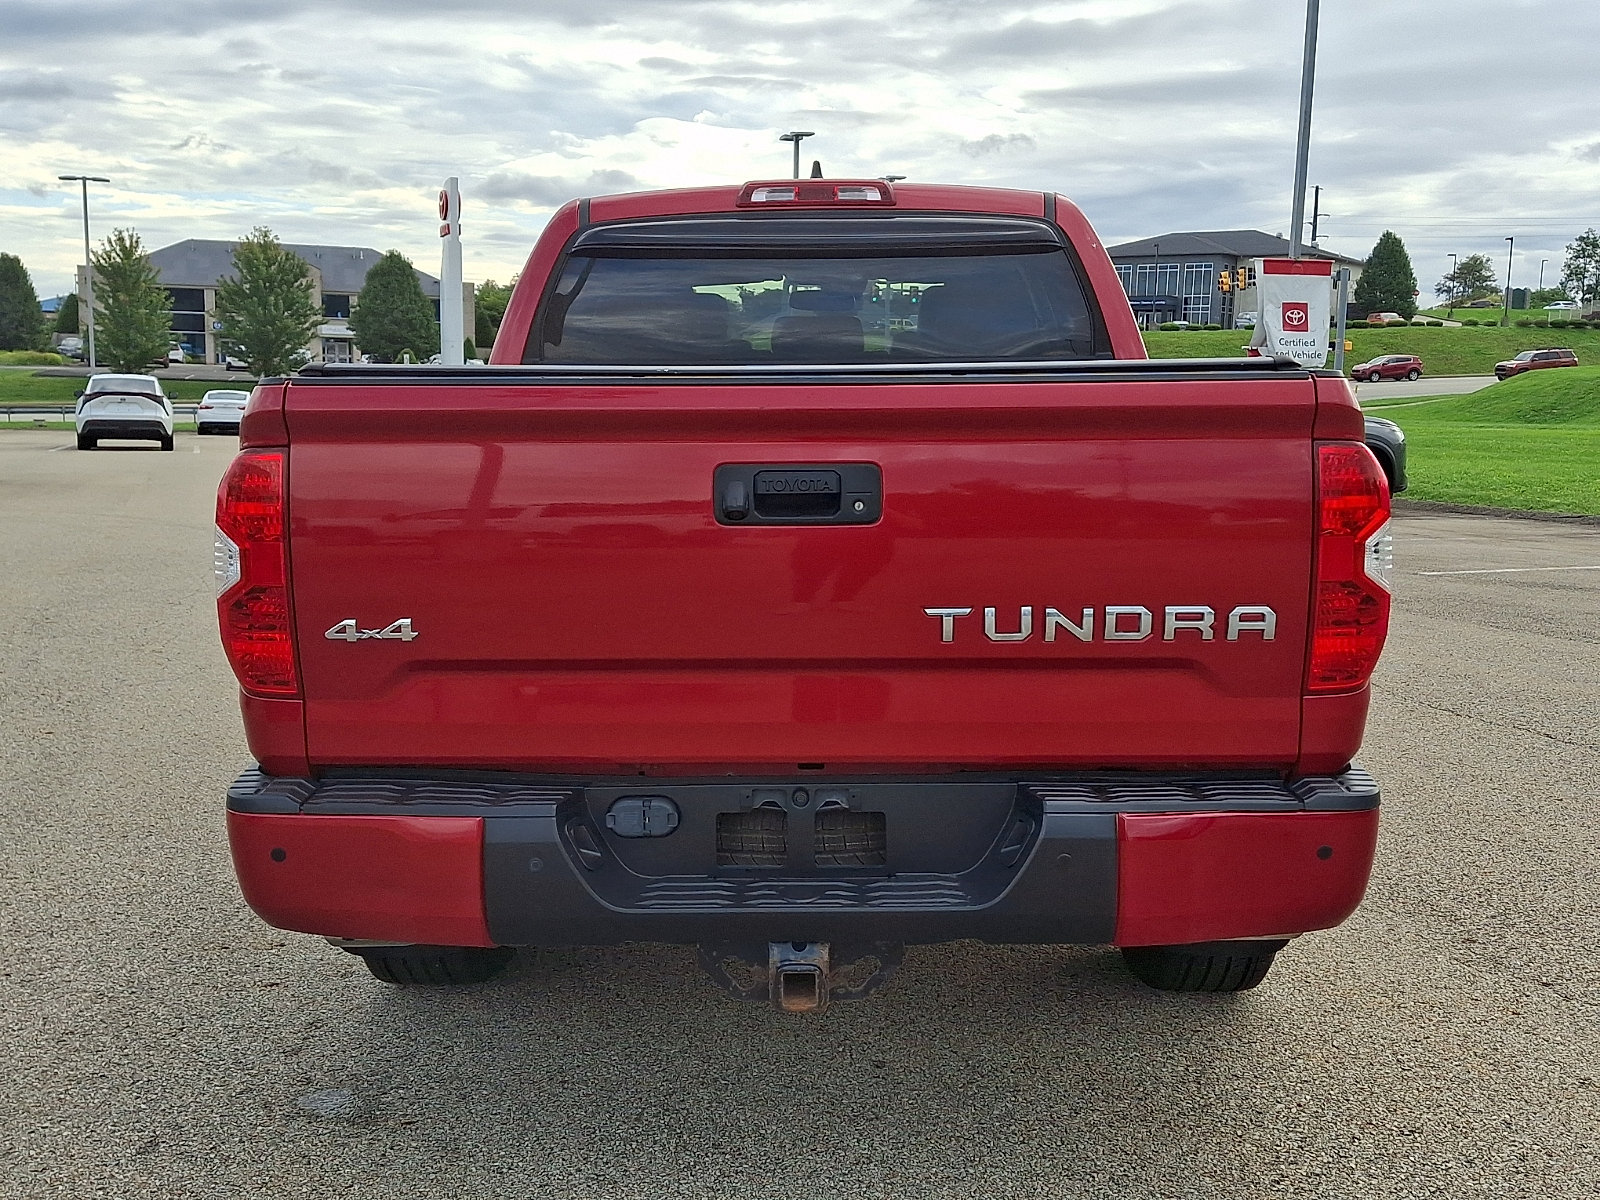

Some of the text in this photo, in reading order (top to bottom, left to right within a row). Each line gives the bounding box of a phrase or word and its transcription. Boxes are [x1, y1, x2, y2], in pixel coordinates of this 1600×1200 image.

[1278, 337, 1316, 347] Certified
[1291, 350, 1322, 359] Vehicle
[762, 479, 833, 492] TOYOTA
[324, 618, 419, 642] 4x4
[923, 605, 1277, 643] TUNDRA
